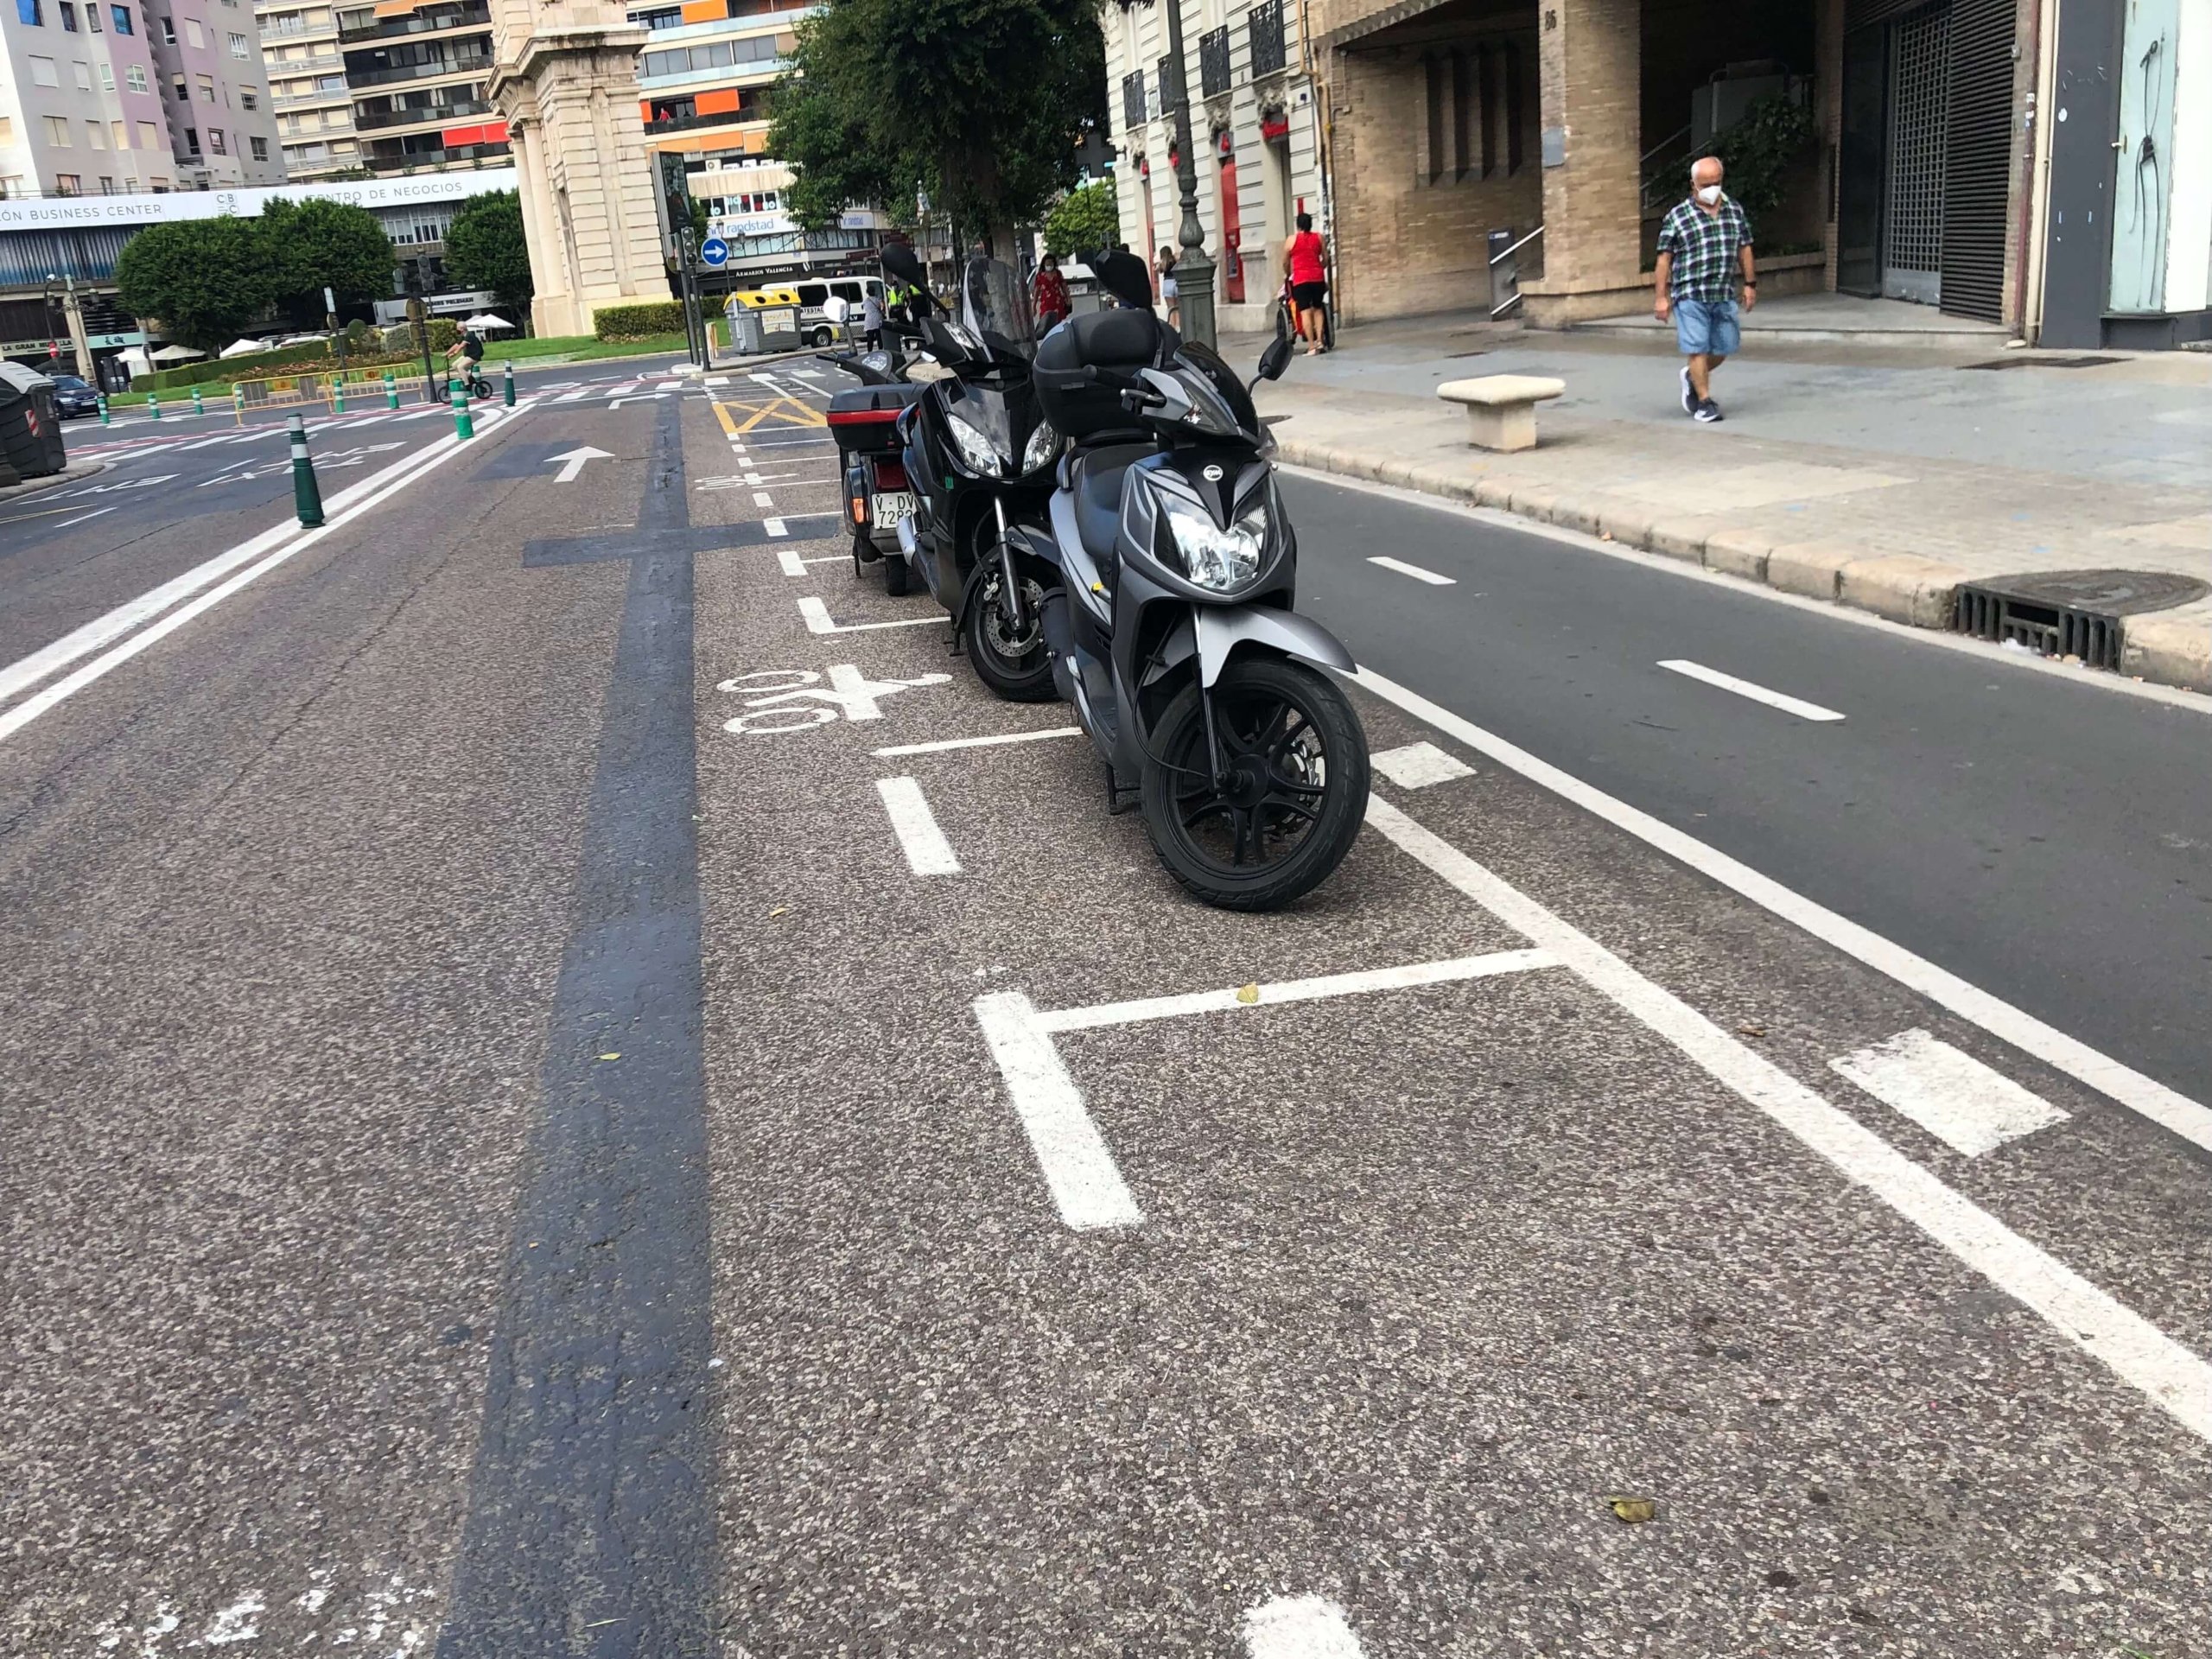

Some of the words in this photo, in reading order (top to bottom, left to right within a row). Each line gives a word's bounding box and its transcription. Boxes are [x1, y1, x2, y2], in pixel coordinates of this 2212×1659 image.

[369, 188, 387, 199] DE
[394, 182, 463, 197] NEGOCIOS
[29, 207, 100, 220] BUSINESS
[107, 204, 162, 216] CENTER
[727, 218, 774, 234] randstad
